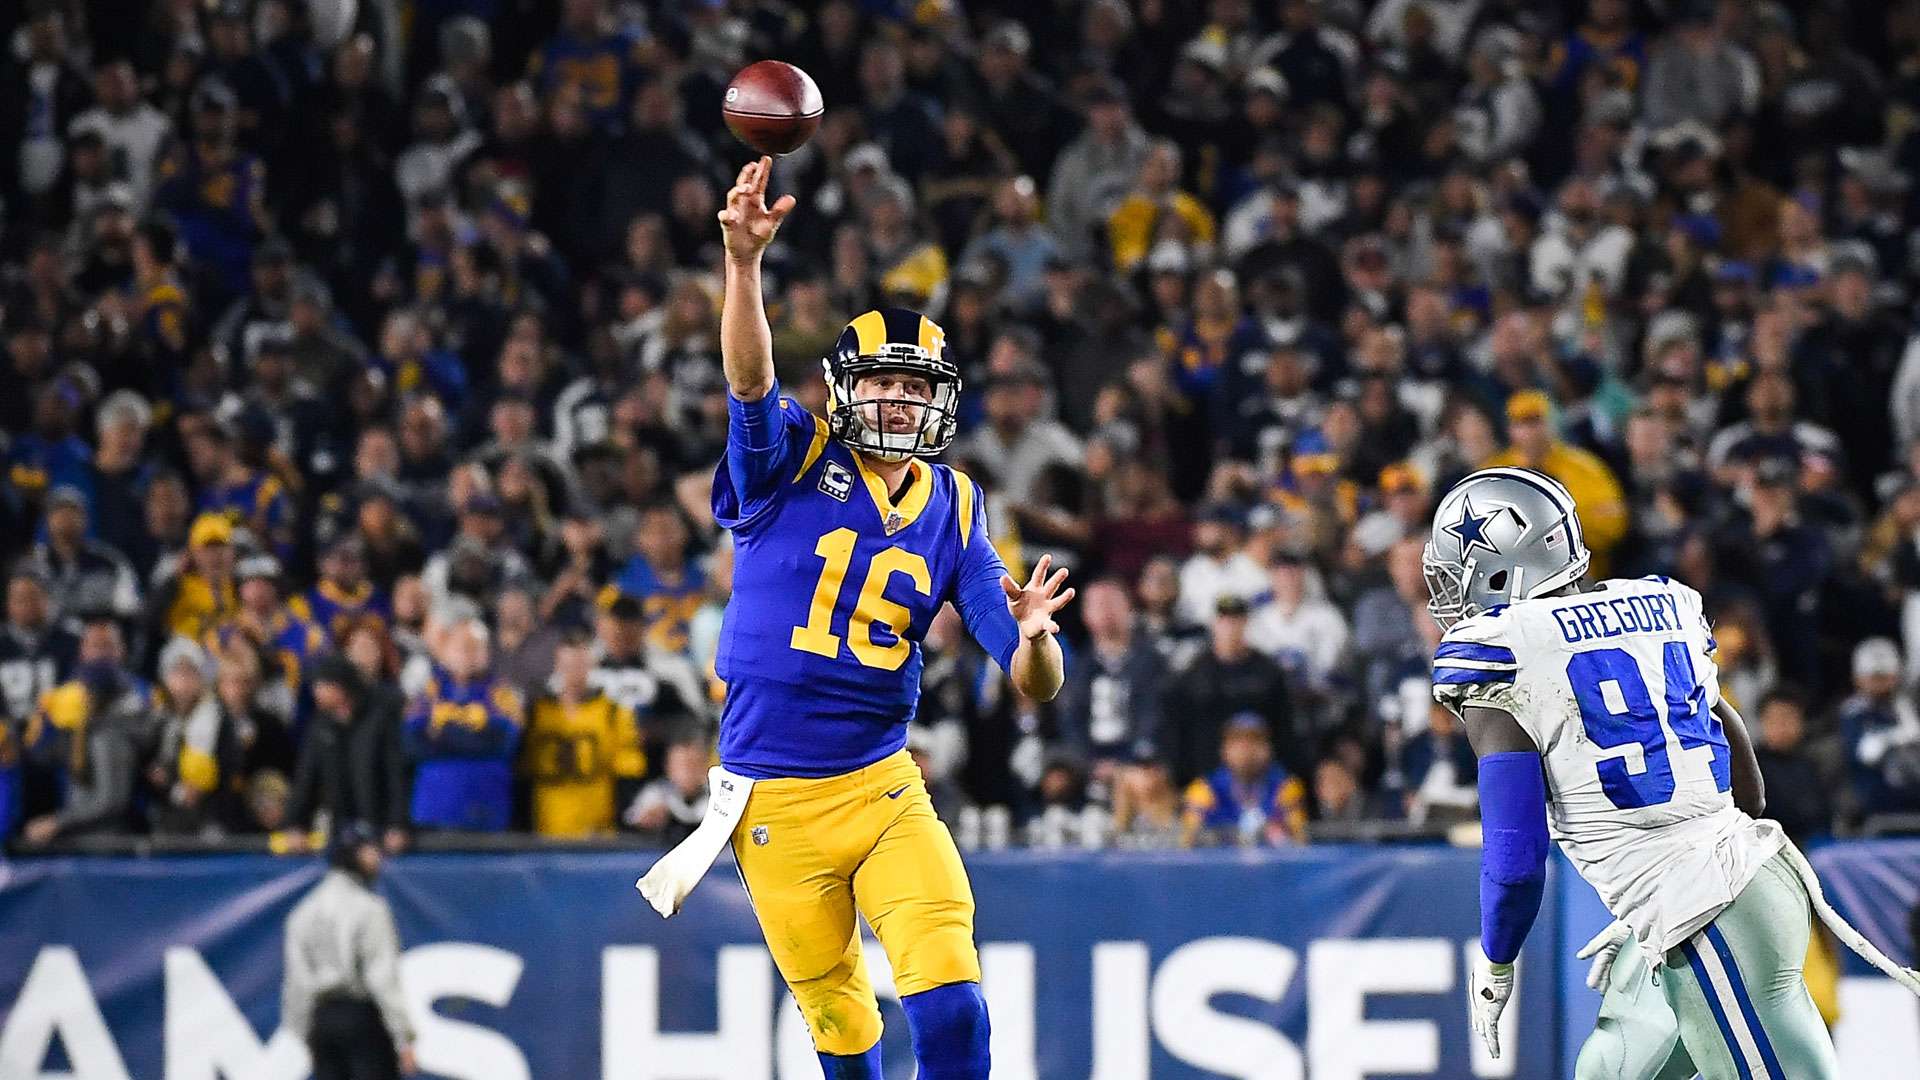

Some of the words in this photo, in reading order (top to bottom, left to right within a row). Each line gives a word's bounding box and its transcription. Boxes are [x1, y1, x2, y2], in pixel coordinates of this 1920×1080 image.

[824, 464, 852, 492] C
[790, 527, 932, 672] 16
[1552, 592, 1683, 643] GREGORY
[1566, 641, 1732, 810] 94
[601, 937, 1522, 1080] HUSE
